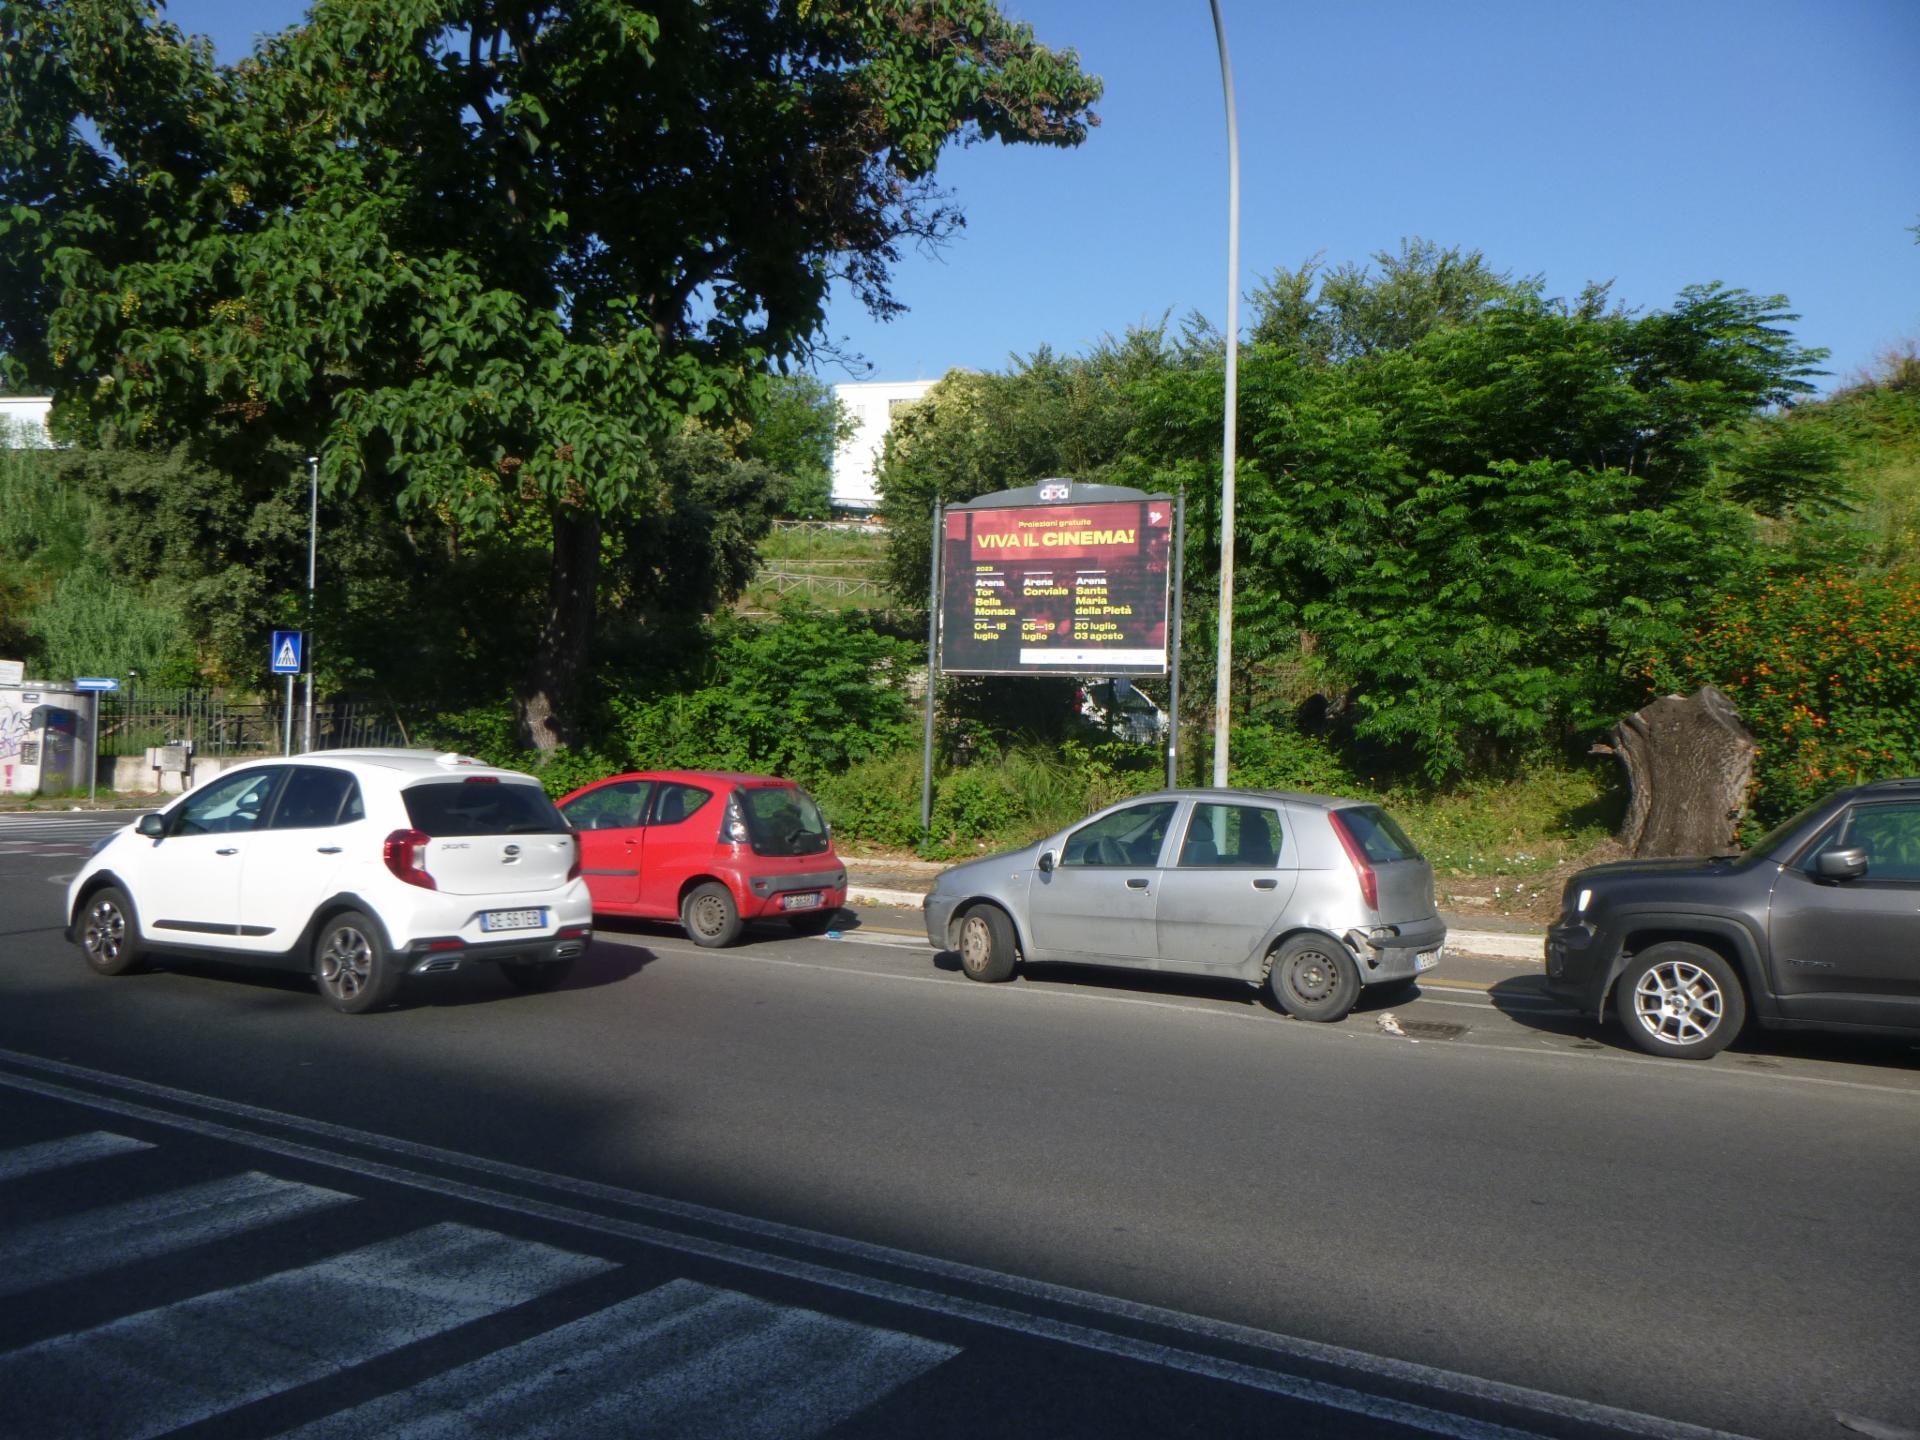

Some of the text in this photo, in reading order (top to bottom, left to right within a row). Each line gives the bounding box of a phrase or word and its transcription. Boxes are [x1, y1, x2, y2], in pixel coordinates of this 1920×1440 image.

[1018, 519, 1092, 528] Proiezioni gratuite
[977, 529, 1136, 549] VIVA IL CINEMA!
[975, 579, 1005, 587] Arena
[1023, 578, 1054, 586] Arena
[1075, 577, 1107, 585] Arena
[975, 588, 994, 596] Tor
[1023, 587, 1069, 596] Corviale
[1075, 586, 1107, 595] Santa
[975, 597, 1001, 606] Bella
[1075, 596, 1107, 605] Maria
[975, 607, 1016, 616] Monaca
[1075, 605, 1132, 615] della Pietà
[1074, 622, 1117, 631] 20 luglio
[974, 632, 999, 641] luglio
[1022, 633, 1048, 641] luglio
[1074, 632, 1124, 641] 03 agosto
